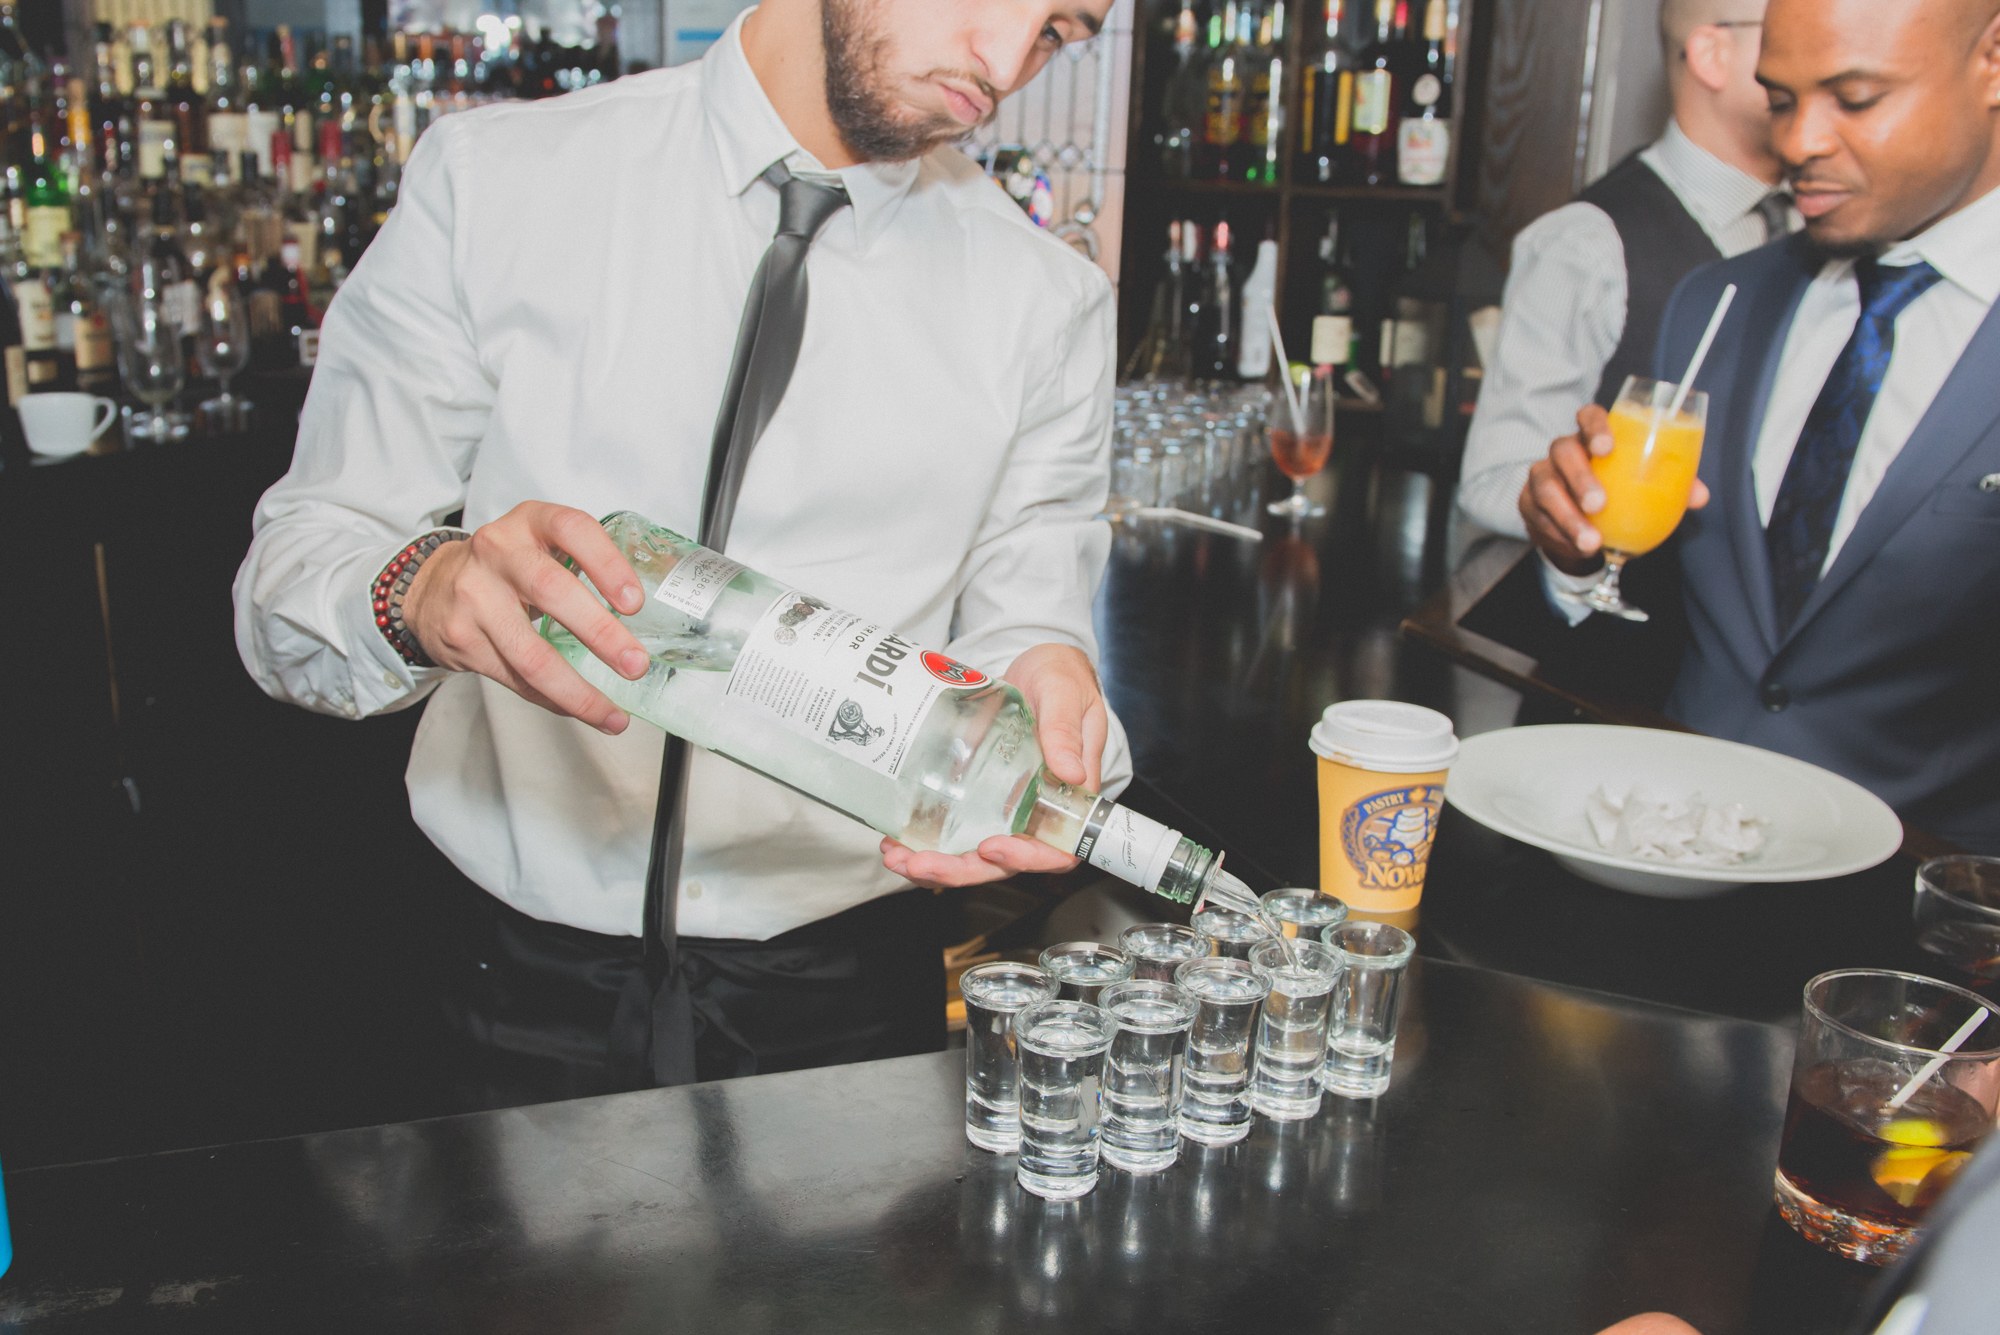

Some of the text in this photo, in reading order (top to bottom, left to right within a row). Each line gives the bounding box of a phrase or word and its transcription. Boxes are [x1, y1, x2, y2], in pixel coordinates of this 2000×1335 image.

[690, 572, 713, 597] 1862
[848, 625, 879, 649] ERIOR
[856, 633, 920, 696] ARDÍ
[1363, 792, 1405, 815] PASTRY
[1076, 835, 1094, 859] WHITE
